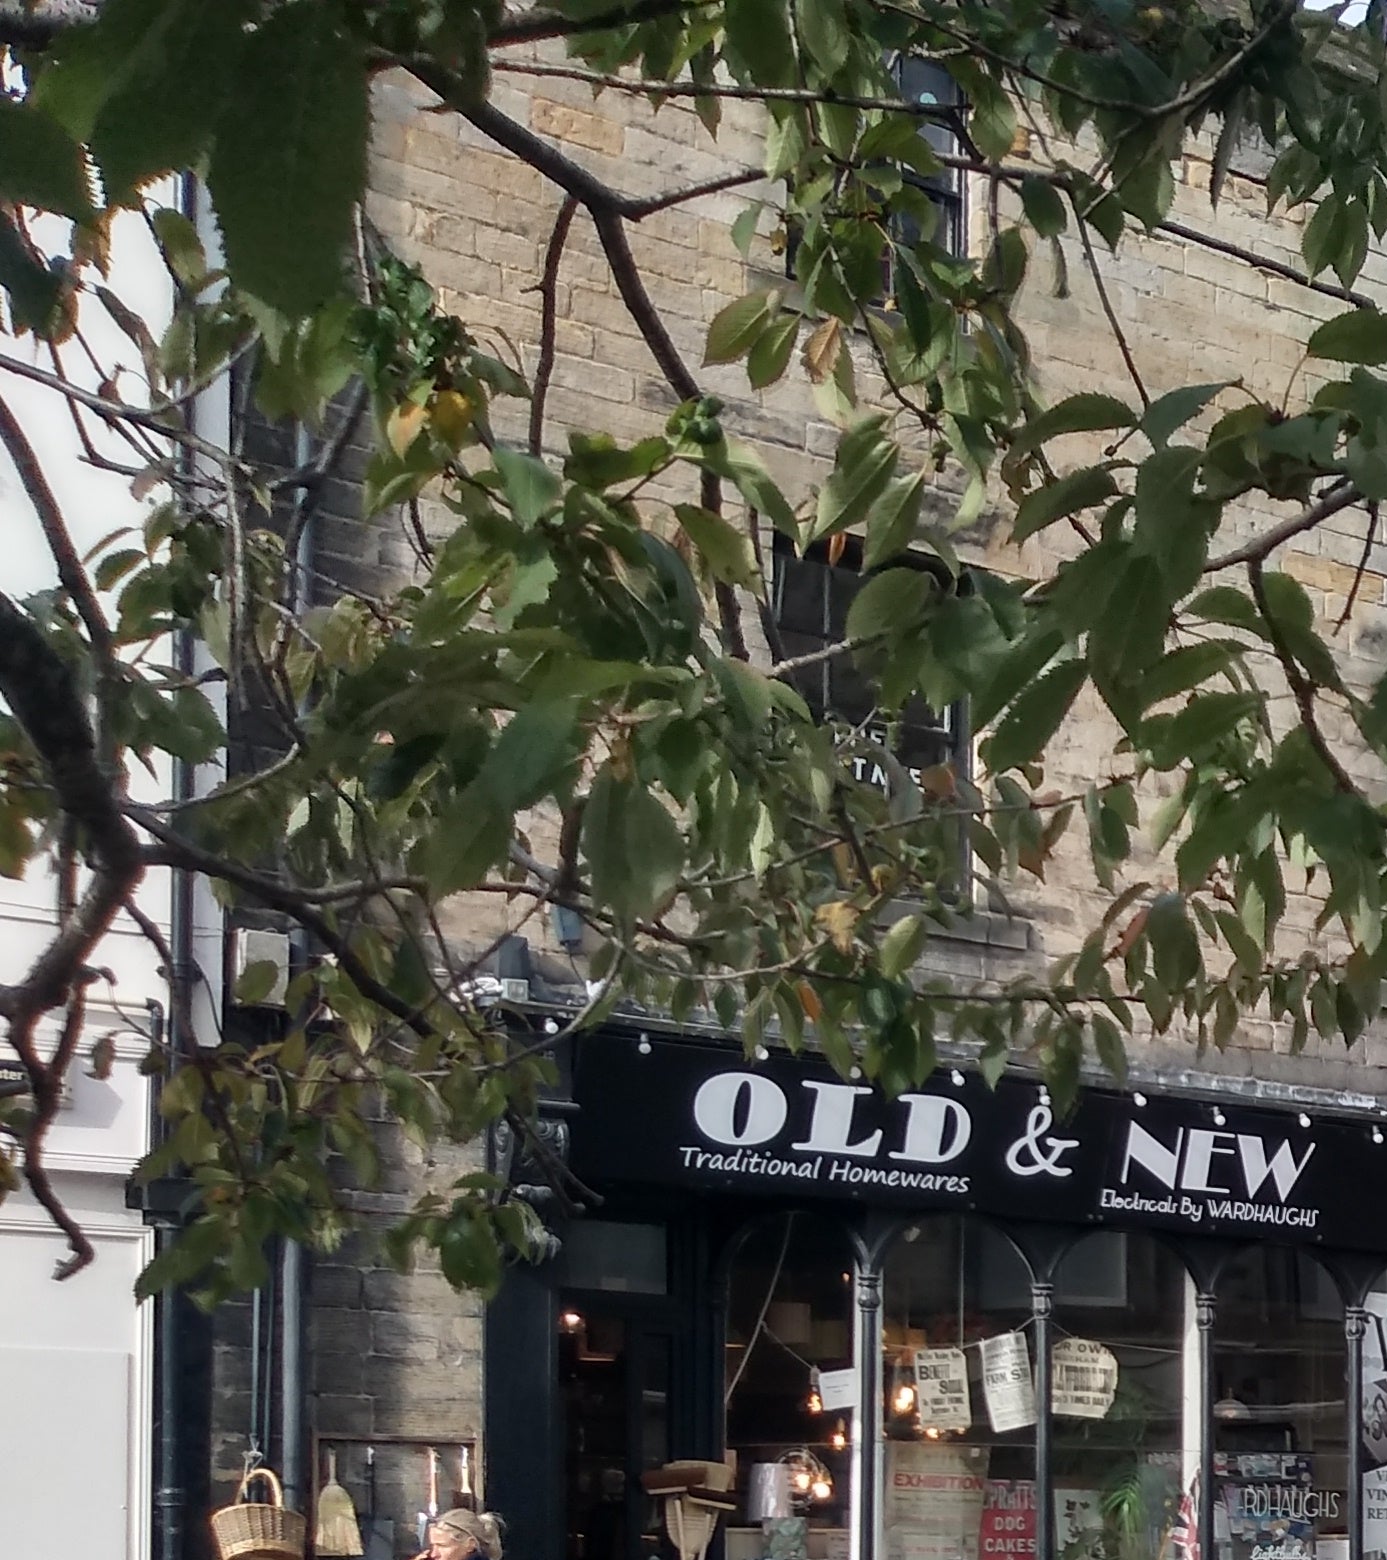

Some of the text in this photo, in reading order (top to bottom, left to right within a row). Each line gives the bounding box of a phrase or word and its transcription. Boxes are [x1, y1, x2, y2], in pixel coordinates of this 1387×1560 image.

[693, 1072, 1316, 1203] OLD & NEW
[679, 1146, 971, 1194] Traditional Homewares
[1180, 1196, 1204, 1222] By
[1206, 1198, 1320, 1228] WARDHAUGHS
[994, 1516, 1026, 1531] DOG
[984, 1537, 1037, 1553] CAKES
